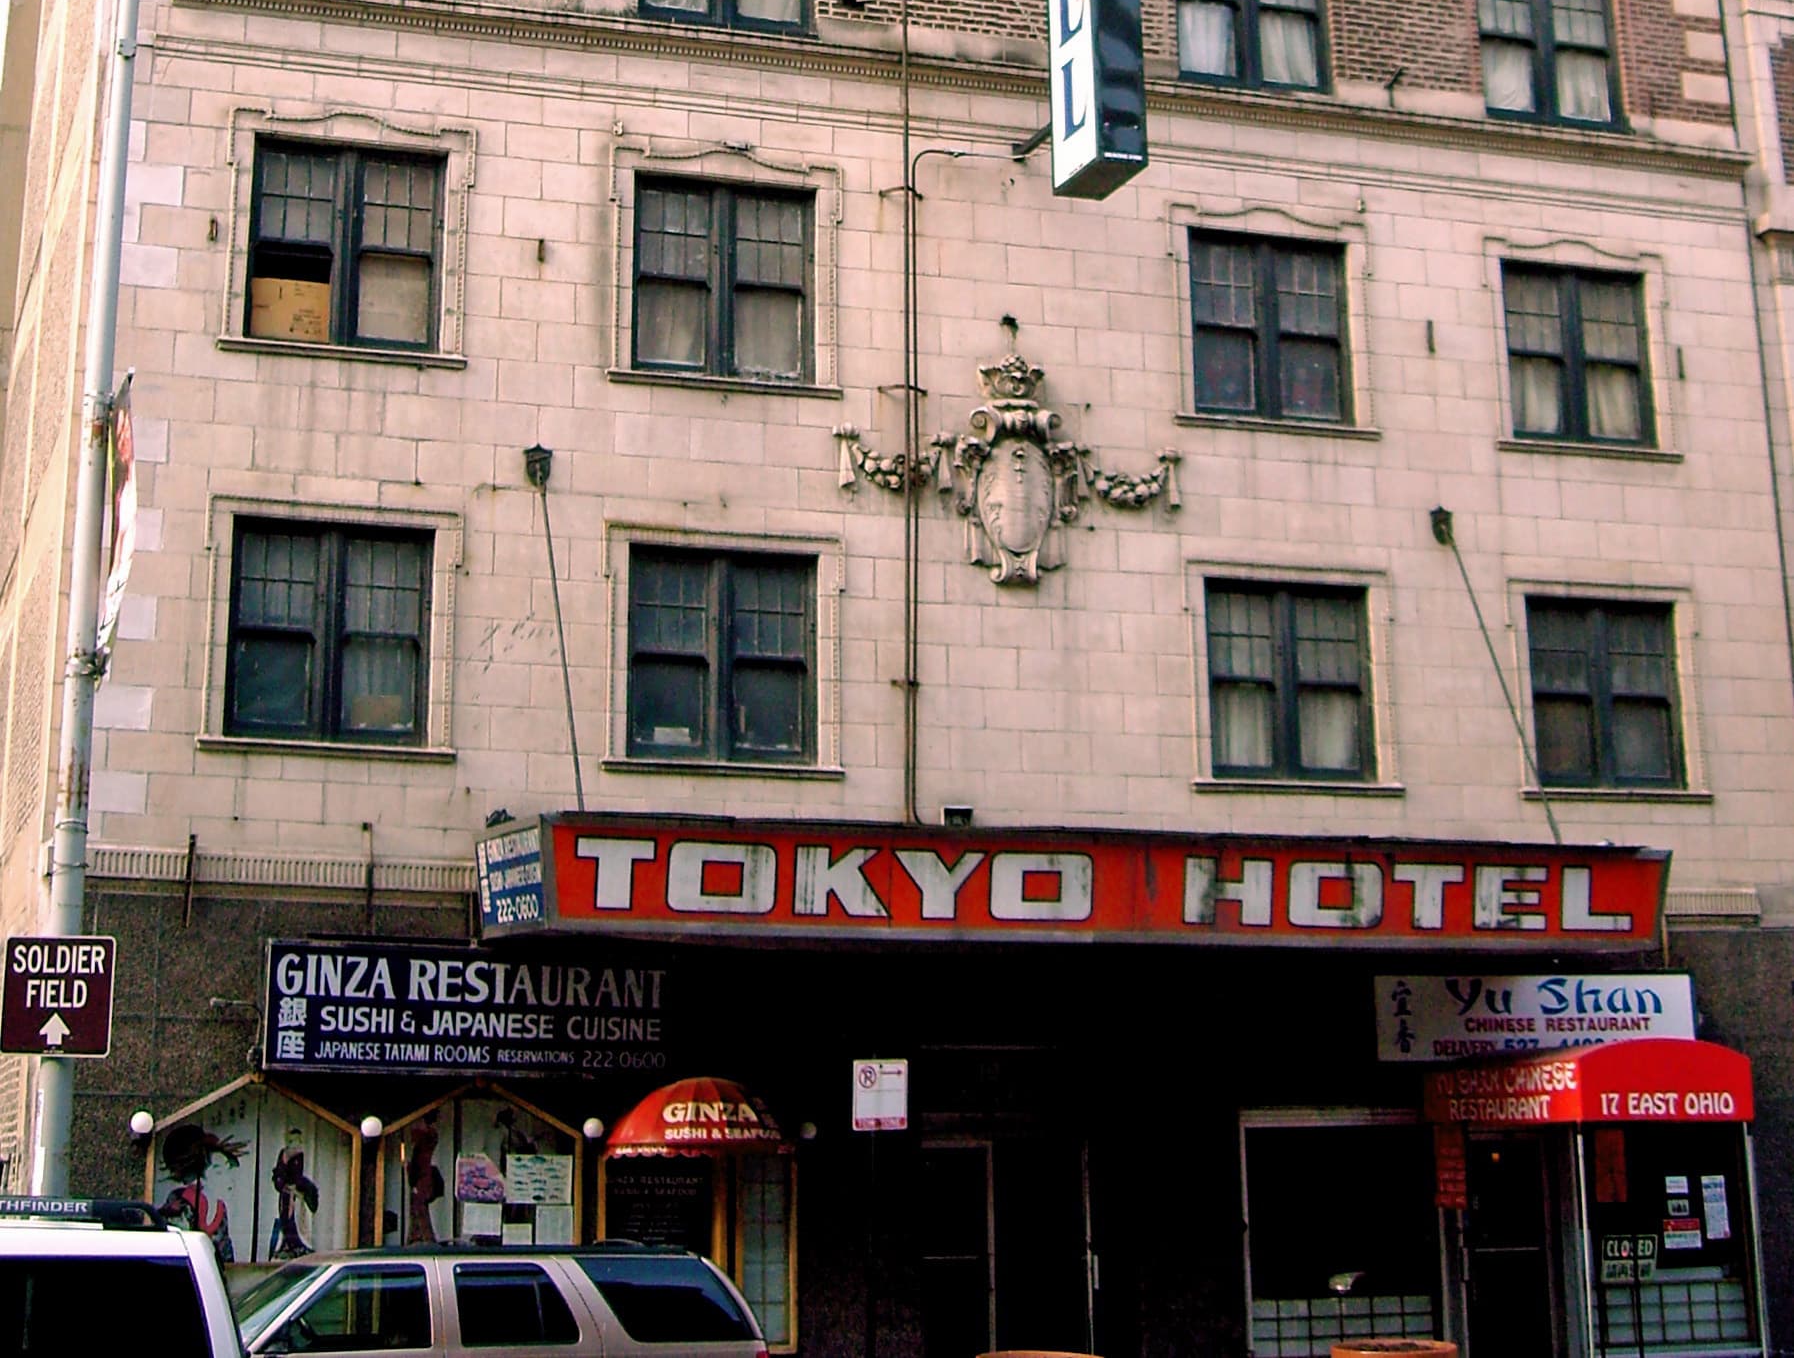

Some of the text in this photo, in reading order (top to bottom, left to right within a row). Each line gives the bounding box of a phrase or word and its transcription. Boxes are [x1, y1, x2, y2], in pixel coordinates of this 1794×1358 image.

[576, 836, 1094, 922] TOKYO
[1183, 854, 1634, 933] HOTEL
[13, 945, 106, 974] SOLDIER
[26, 979, 88, 1008] FIELD
[276, 953, 667, 1009] GINZA RESTAURANT
[1445, 978, 1664, 1015] Yu Shan
[277, 997, 307, 1060] 銀座
[320, 1005, 662, 1042] SUSHI & JAPANESE CUISINE
[1464, 1016, 1652, 1034] CHINESE RESTAURANT
[314, 1041, 381, 1061] JAPANESE
[384, 1042, 430, 1063] TATAMI
[433, 1044, 491, 1064] ROOMS
[496, 1048, 575, 1065] RESERVATIONS
[582, 1050, 614, 1068] 222
[1503, 1062, 1578, 1093] CHINESE
[662, 1101, 759, 1123] GINZA
[1449, 1095, 1551, 1121] RESTAURANT
[1600, 1091, 1735, 1116] 17 EAST OHIO
[664, 1127, 708, 1140] SUSHI
[711, 1127, 723, 1140] &
[1606, 1239, 1653, 1258] CLOED
